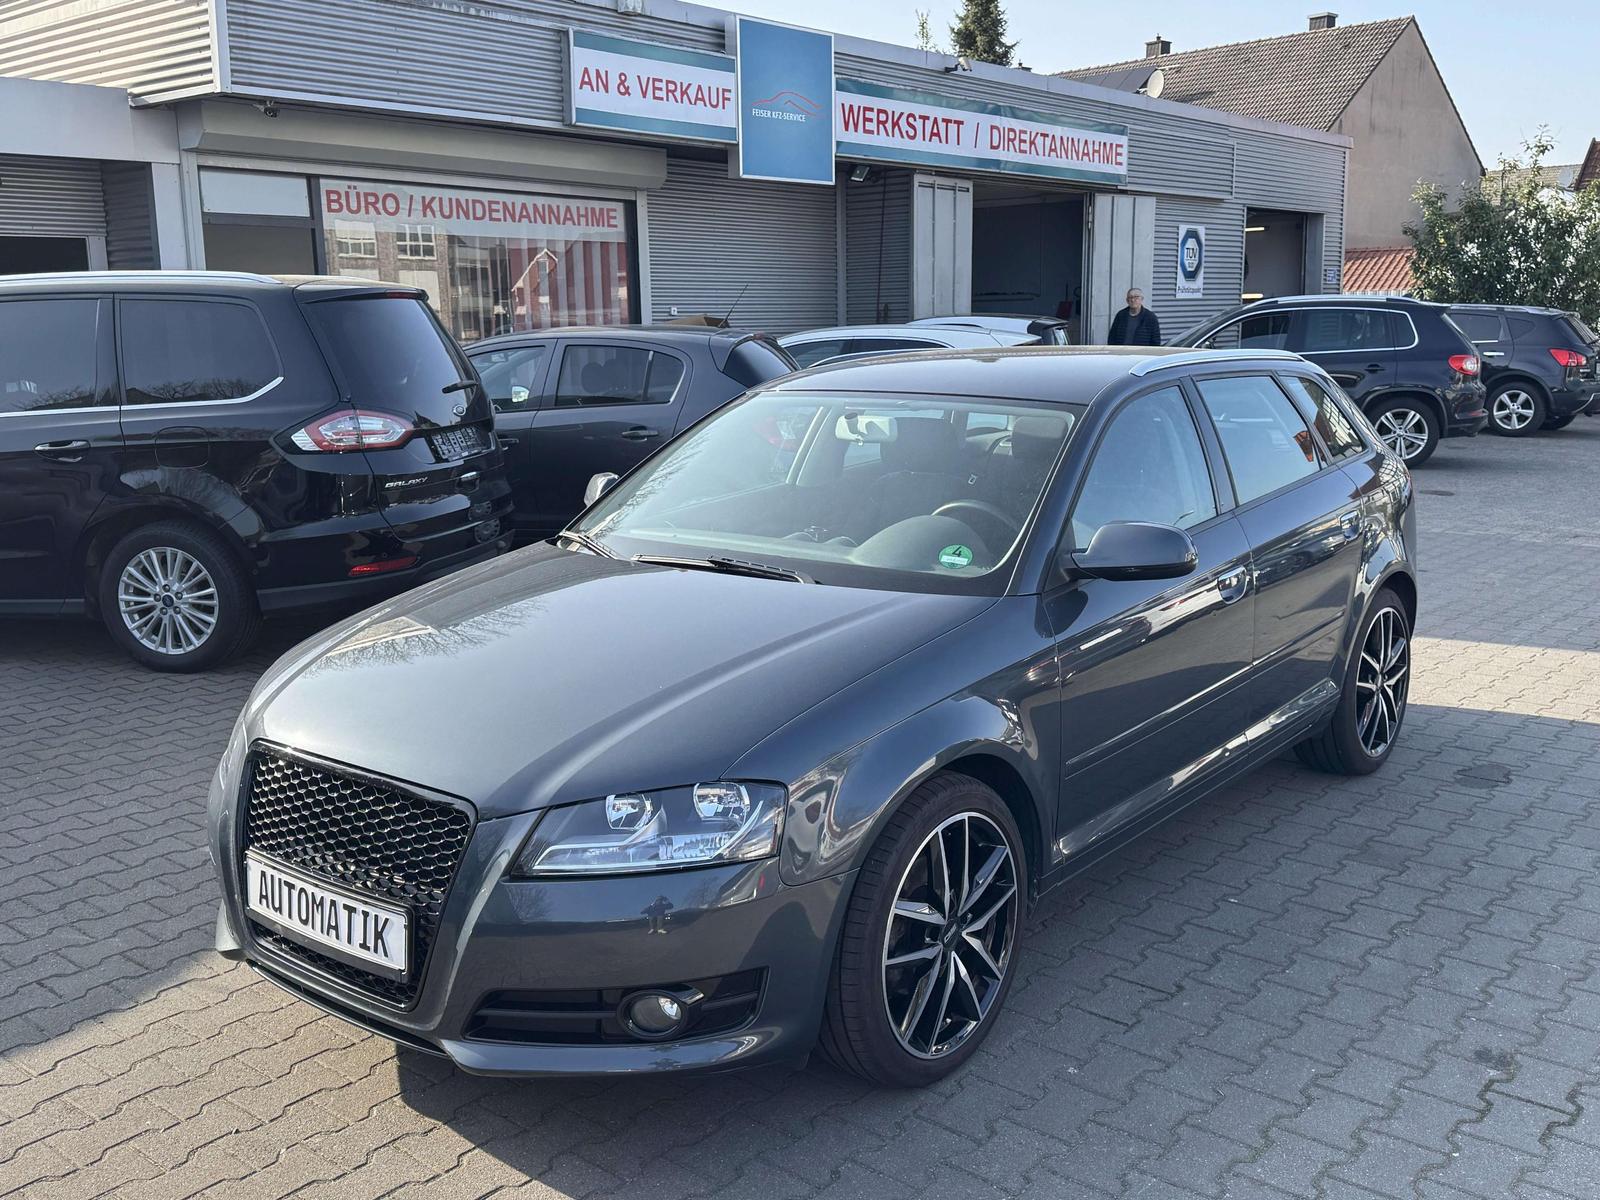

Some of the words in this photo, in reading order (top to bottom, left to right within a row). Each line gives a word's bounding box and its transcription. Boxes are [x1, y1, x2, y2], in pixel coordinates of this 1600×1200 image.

[579, 67, 609, 94] AN
[617, 72, 631, 97] &
[637, 75, 732, 110] VERKAUF
[752, 108, 771, 118] FEISER
[772, 111, 806, 122] KFZ-SERVICE
[841, 102, 964, 146] WERKSTATT
[974, 122, 979, 149] /
[989, 125, 1123, 166] DIREKTANNAHME
[325, 185, 400, 216] BÜRO
[408, 194, 414, 218] /
[421, 195, 618, 229] KUNDENANNAHME
[384, 477, 428, 488] GALAXY
[952, 546, 962, 557] 4
[259, 870, 390, 958] AUTOMATIK
